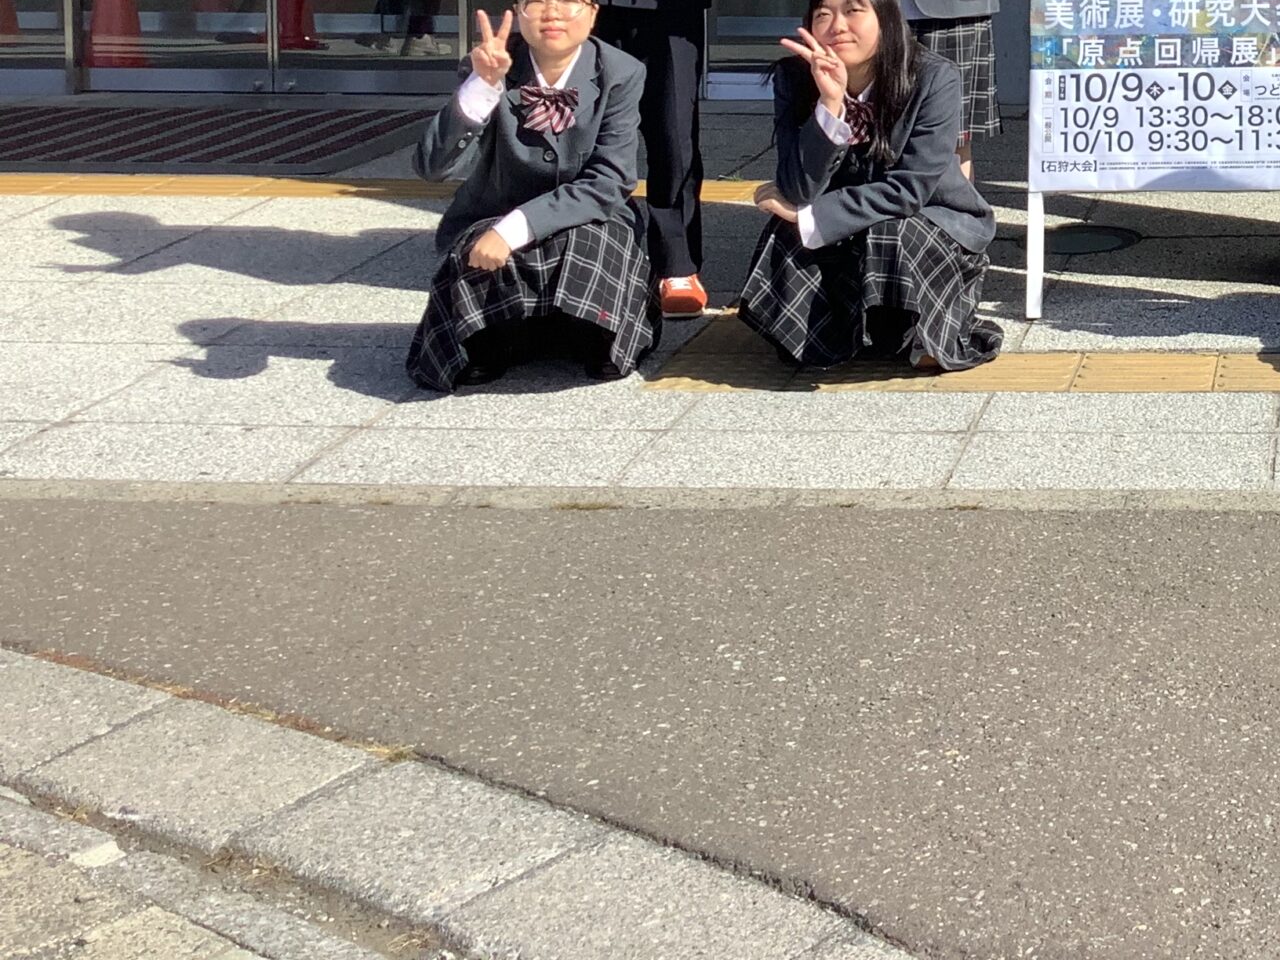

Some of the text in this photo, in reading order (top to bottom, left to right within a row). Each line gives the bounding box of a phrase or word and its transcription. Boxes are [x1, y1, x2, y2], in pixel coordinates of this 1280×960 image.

[1062, 37, 1277, 67] 「原点回帰展」
[1060, 105, 1119, 130] 10/9
[1060, 129, 1134, 154] 10/10
